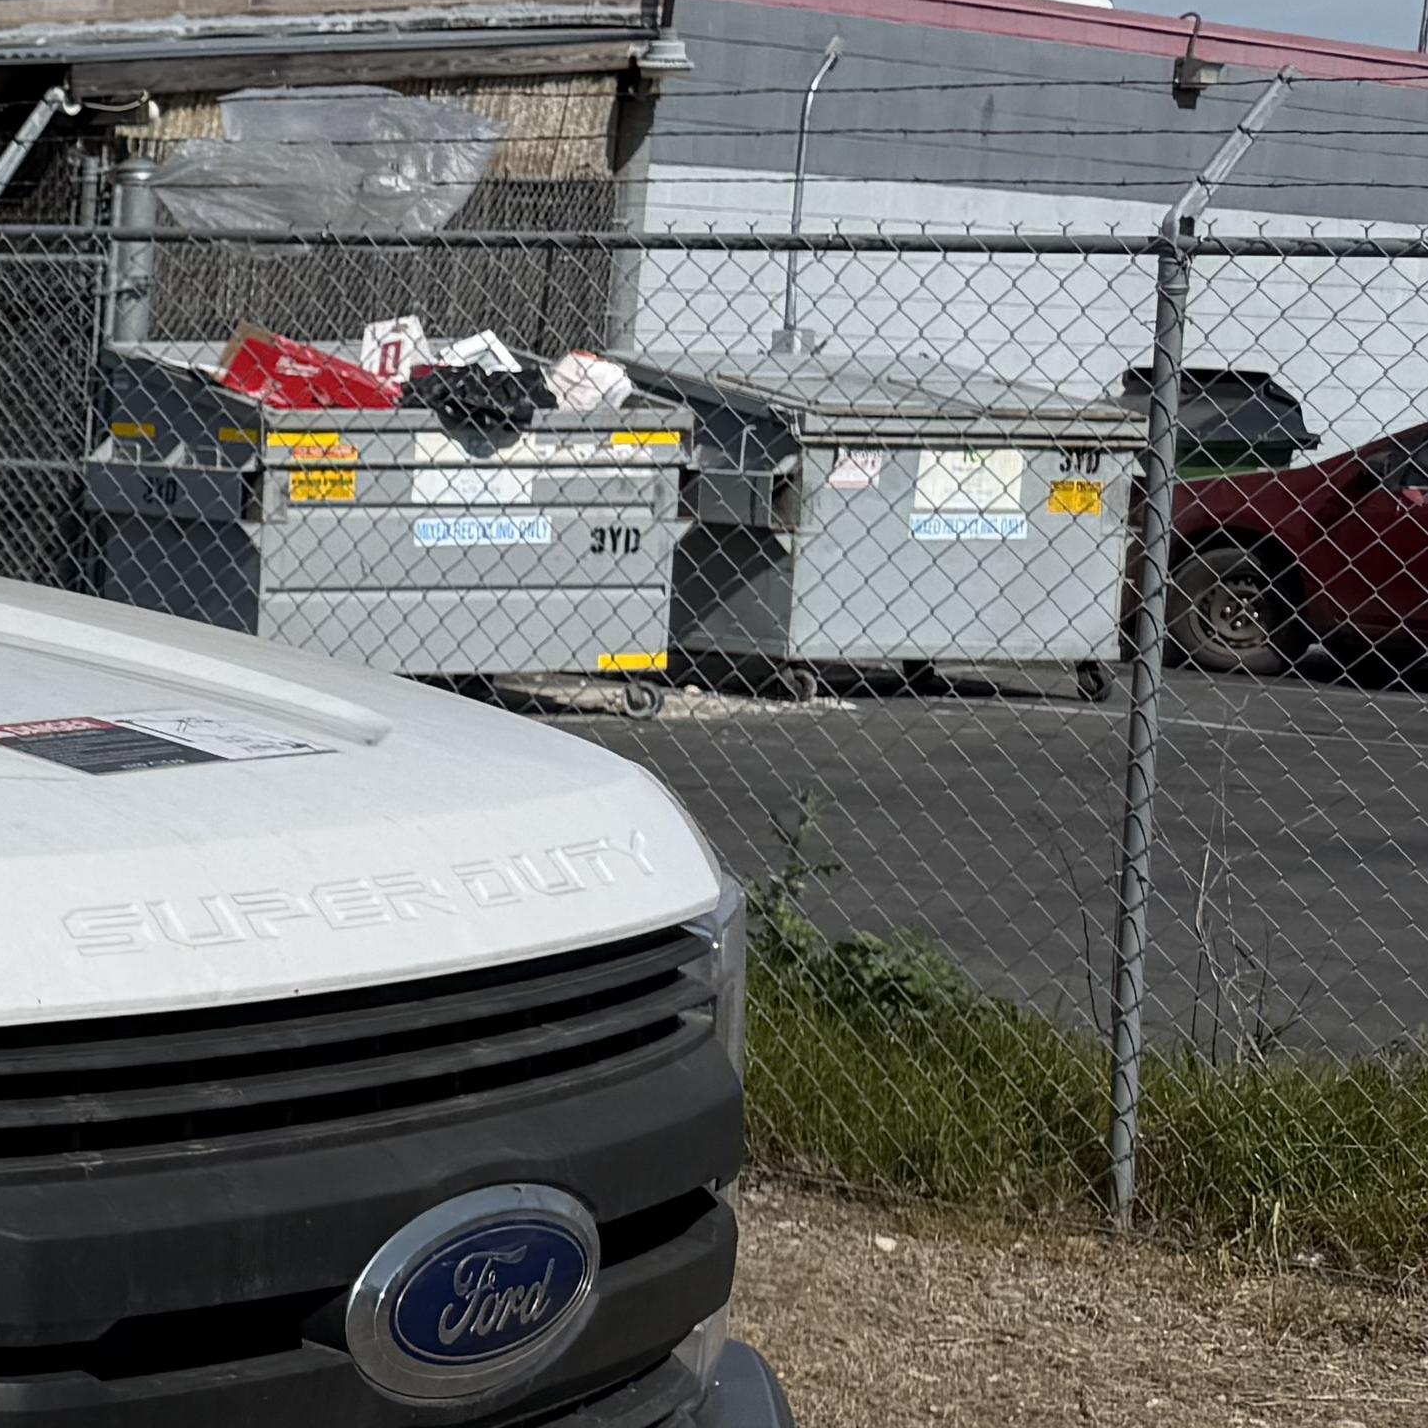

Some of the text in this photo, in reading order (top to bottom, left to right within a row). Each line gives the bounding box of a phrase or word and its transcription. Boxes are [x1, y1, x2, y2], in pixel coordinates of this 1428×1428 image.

[590, 524, 641, 554] 3YD
[61, 829, 657, 958] SUPER DUTY
[438, 1244, 556, 1346] Ford
